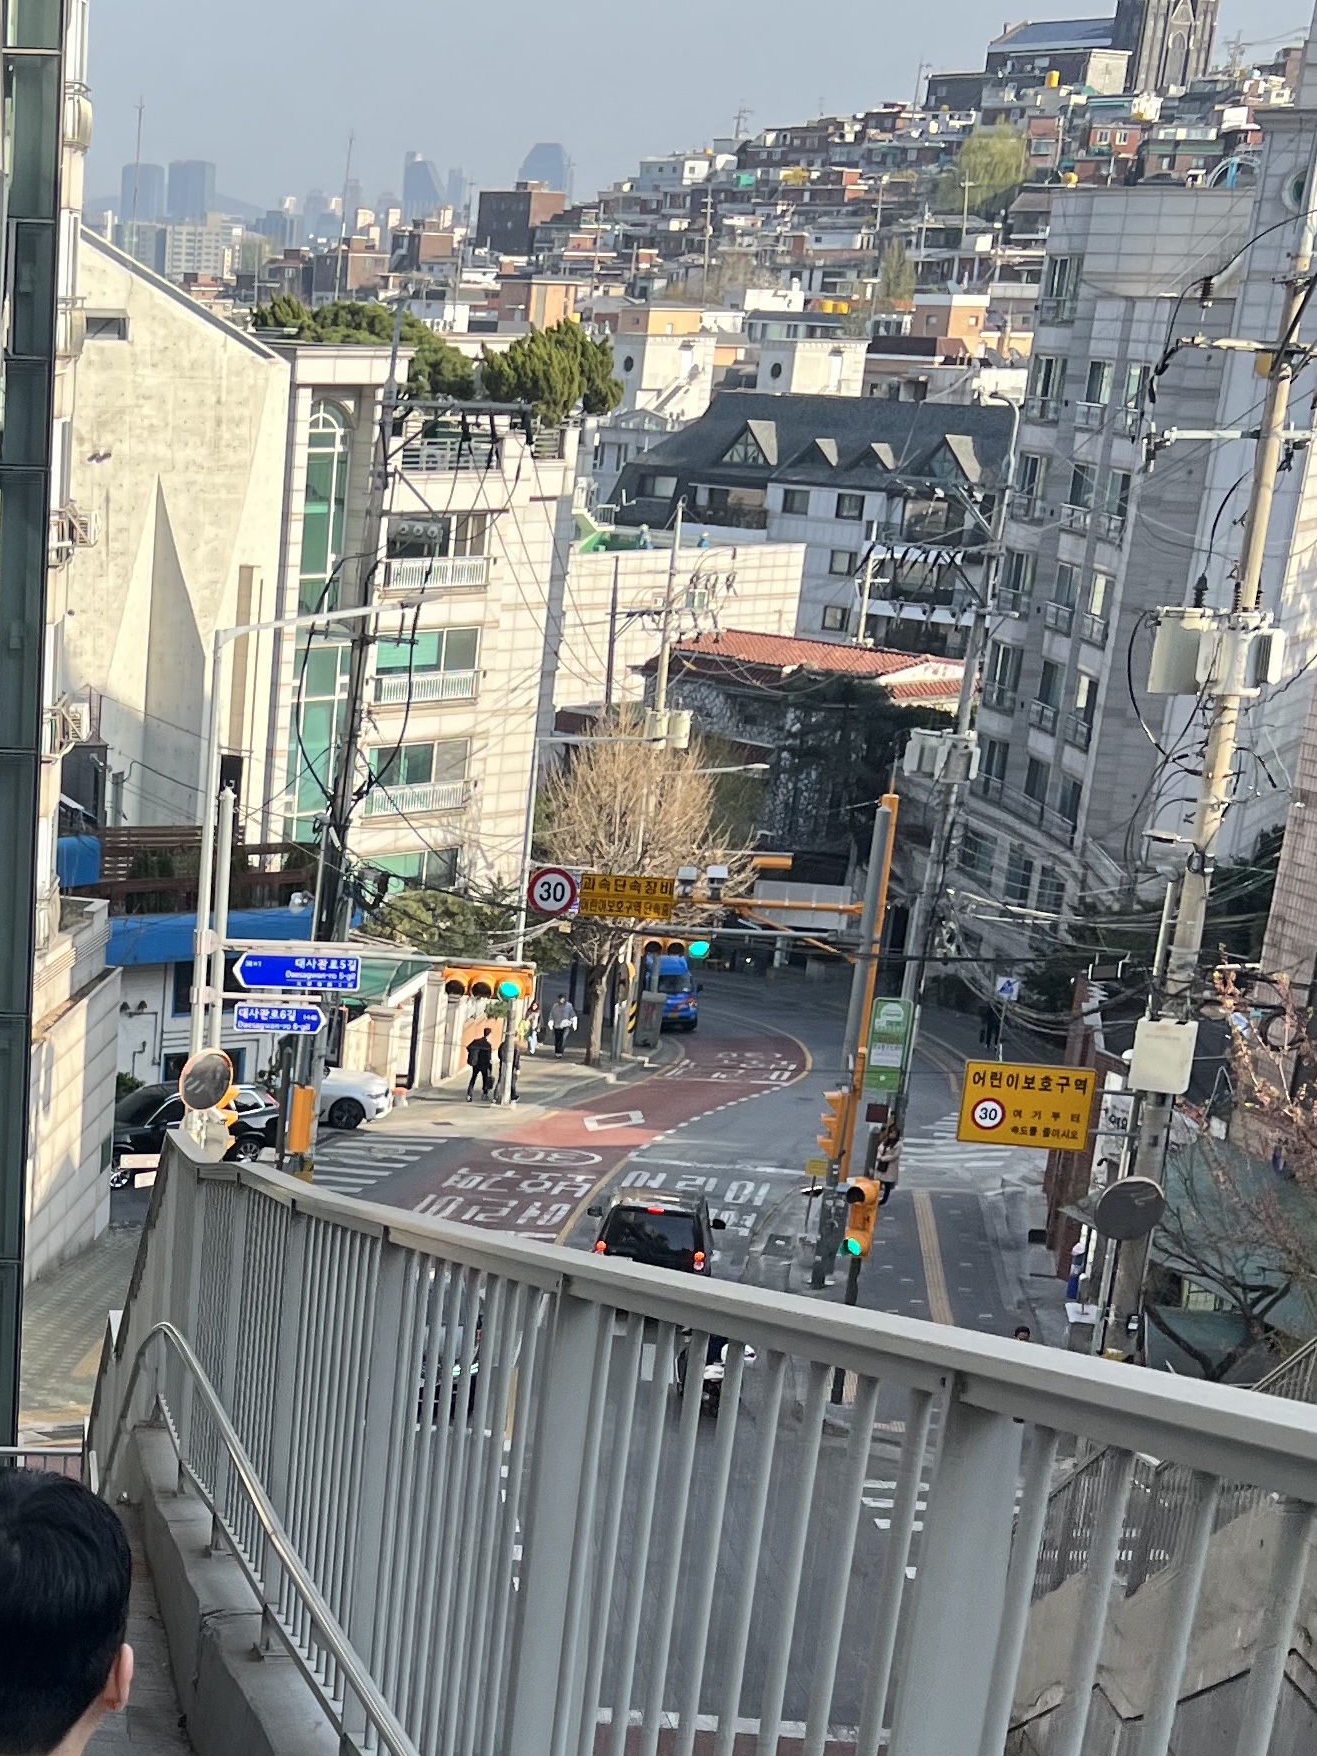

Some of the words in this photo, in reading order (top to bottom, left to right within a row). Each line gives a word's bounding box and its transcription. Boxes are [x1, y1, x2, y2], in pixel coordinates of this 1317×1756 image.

[538, 881, 566, 902] 30
[972, 1070, 1089, 1096] 어린이보호구역
[978, 1107, 998, 1121] 30
